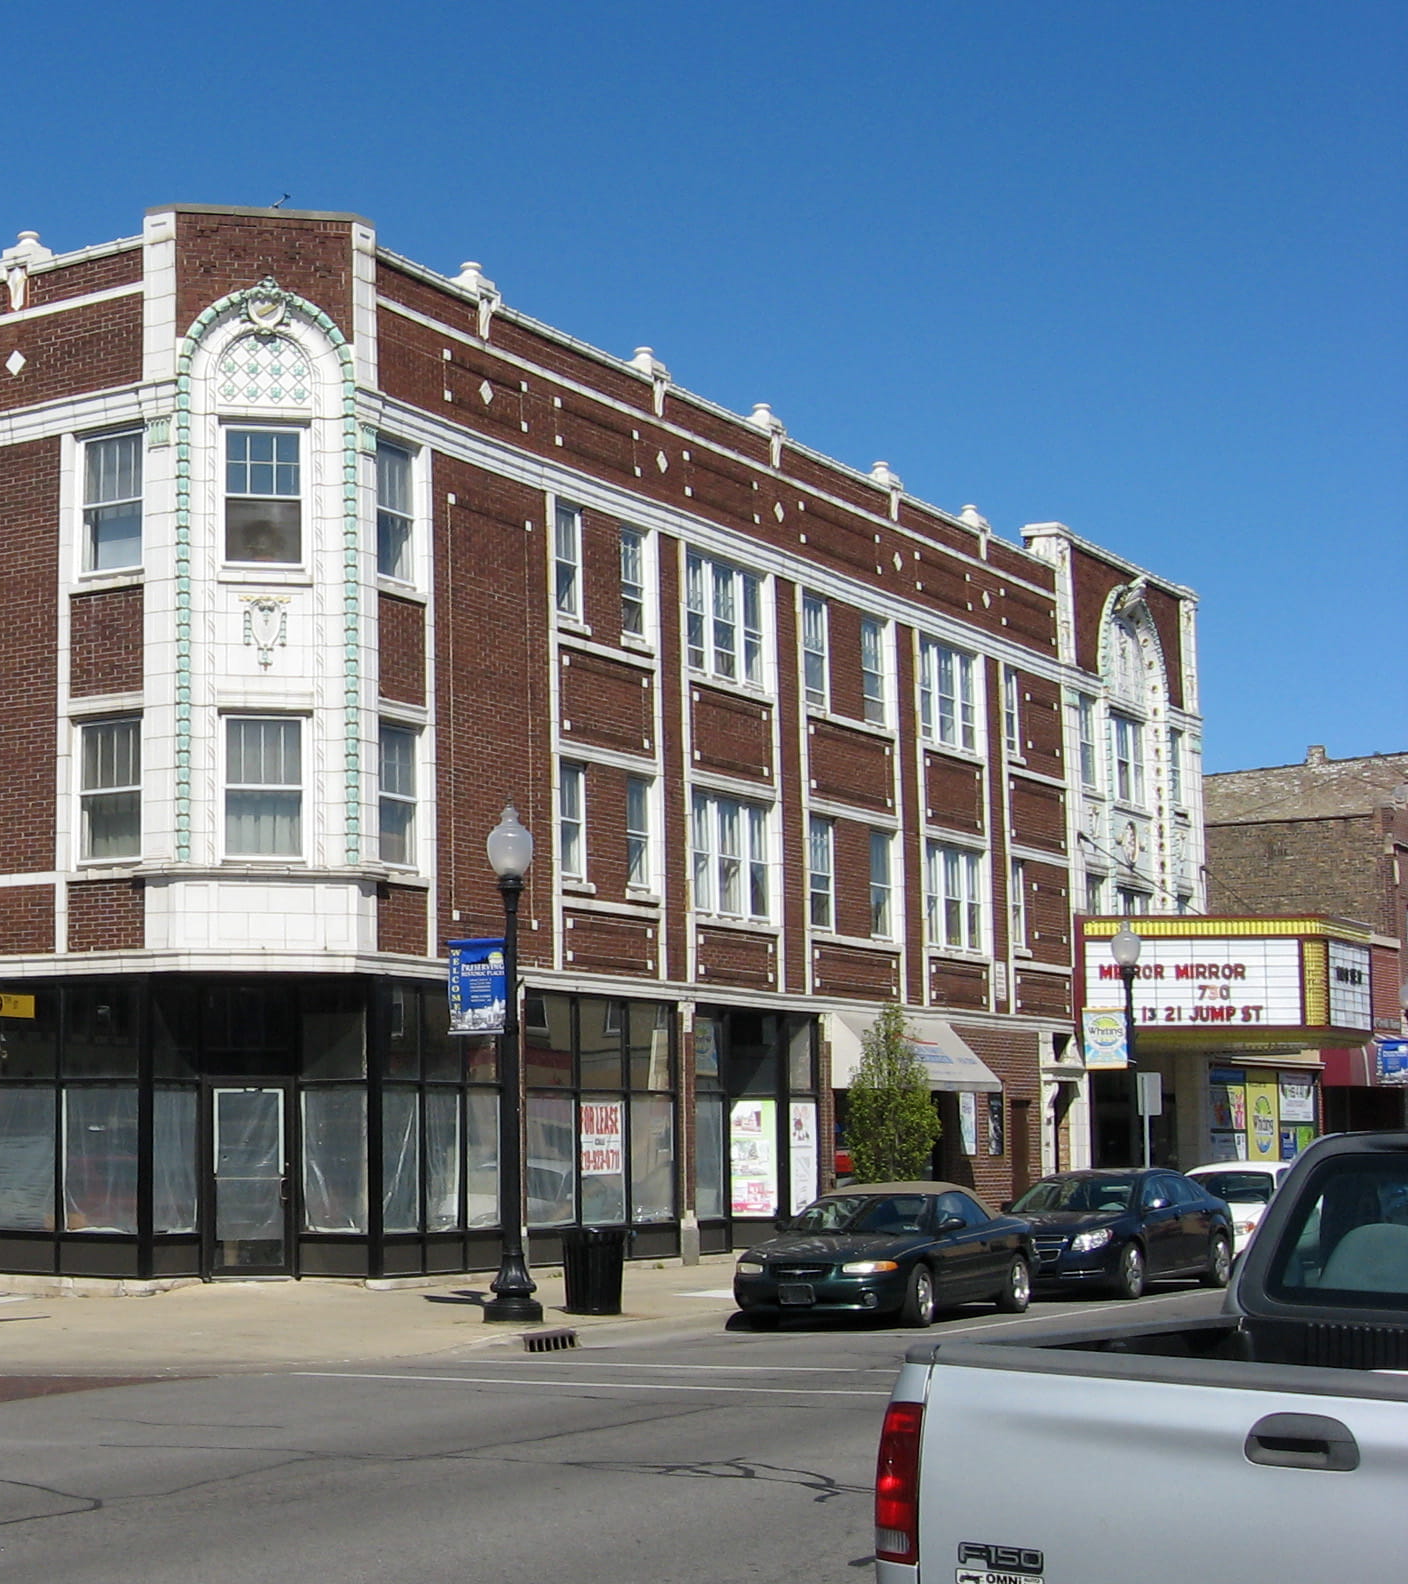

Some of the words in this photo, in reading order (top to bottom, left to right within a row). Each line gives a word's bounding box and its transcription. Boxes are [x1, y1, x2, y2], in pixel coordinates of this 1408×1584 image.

[461, 962, 504, 971] PRESERVING
[1099, 964, 1164, 980] MIROR
[1175, 964, 1246, 980] MIRROR
[451, 949, 461, 1010] WELCOME
[1165, 1006, 1182, 1022] 21
[1189, 1006, 1236, 1022] JUMP
[1242, 1006, 1264, 1022] ST
[1088, 1026, 1123, 1037] Whiting
[596, 1106, 618, 1134] LEASE
